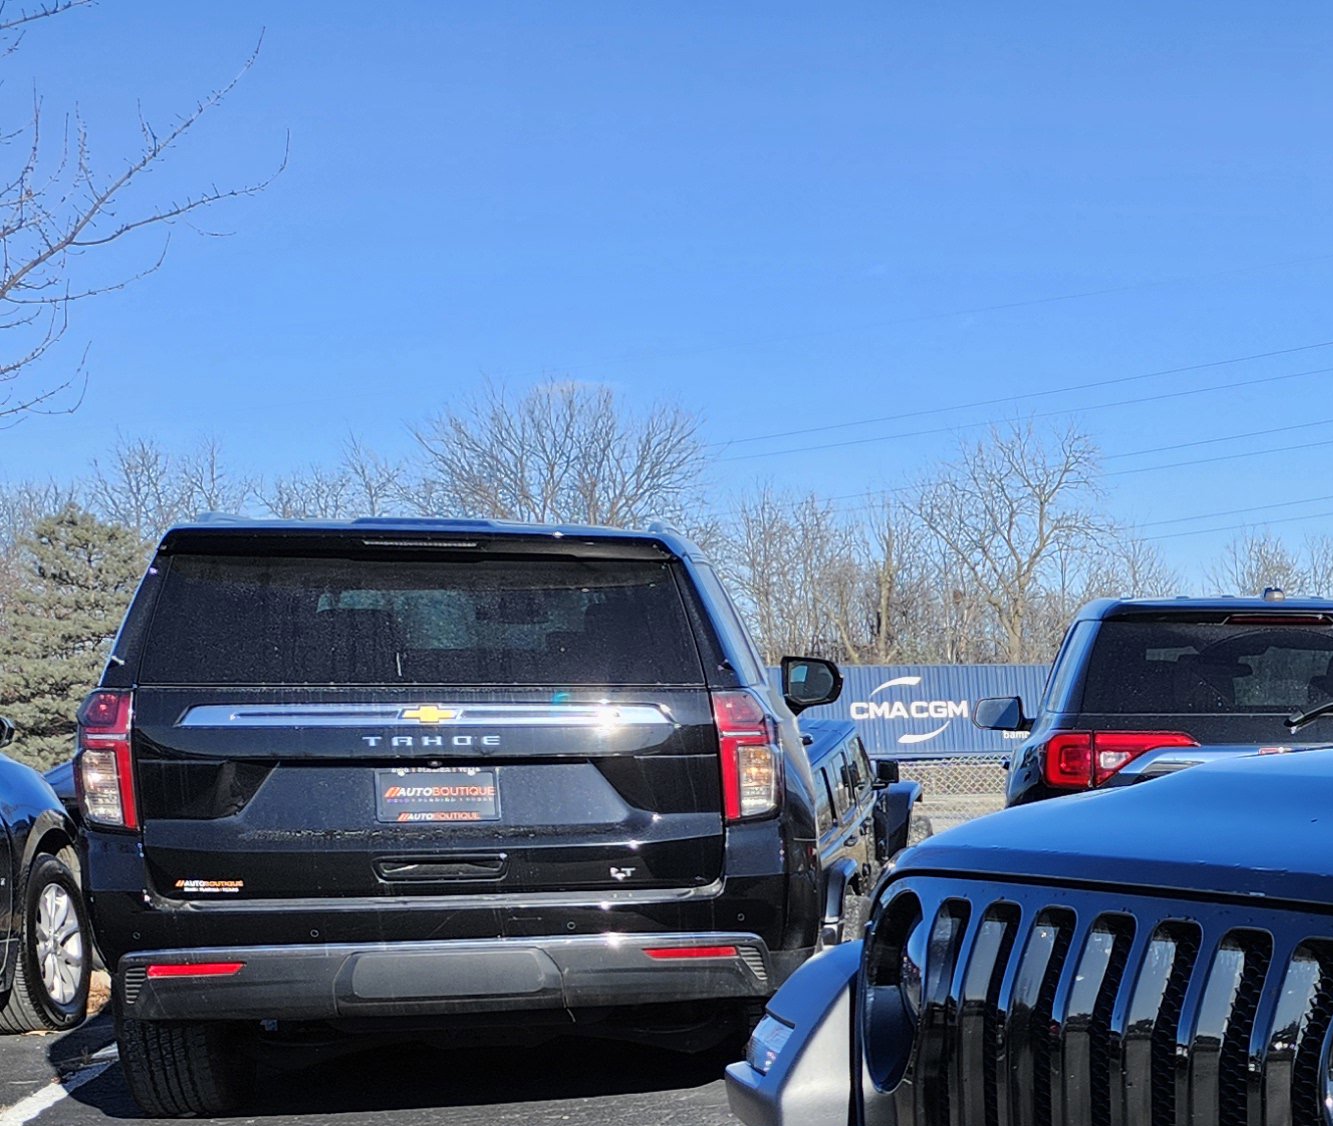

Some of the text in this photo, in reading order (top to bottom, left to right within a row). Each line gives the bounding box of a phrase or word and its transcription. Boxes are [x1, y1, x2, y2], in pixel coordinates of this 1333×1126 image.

[851, 701, 968, 719] CMA CGM
[362, 735, 500, 746] TAHOE
[399, 786, 497, 798] AUTOBOUTIQUE
